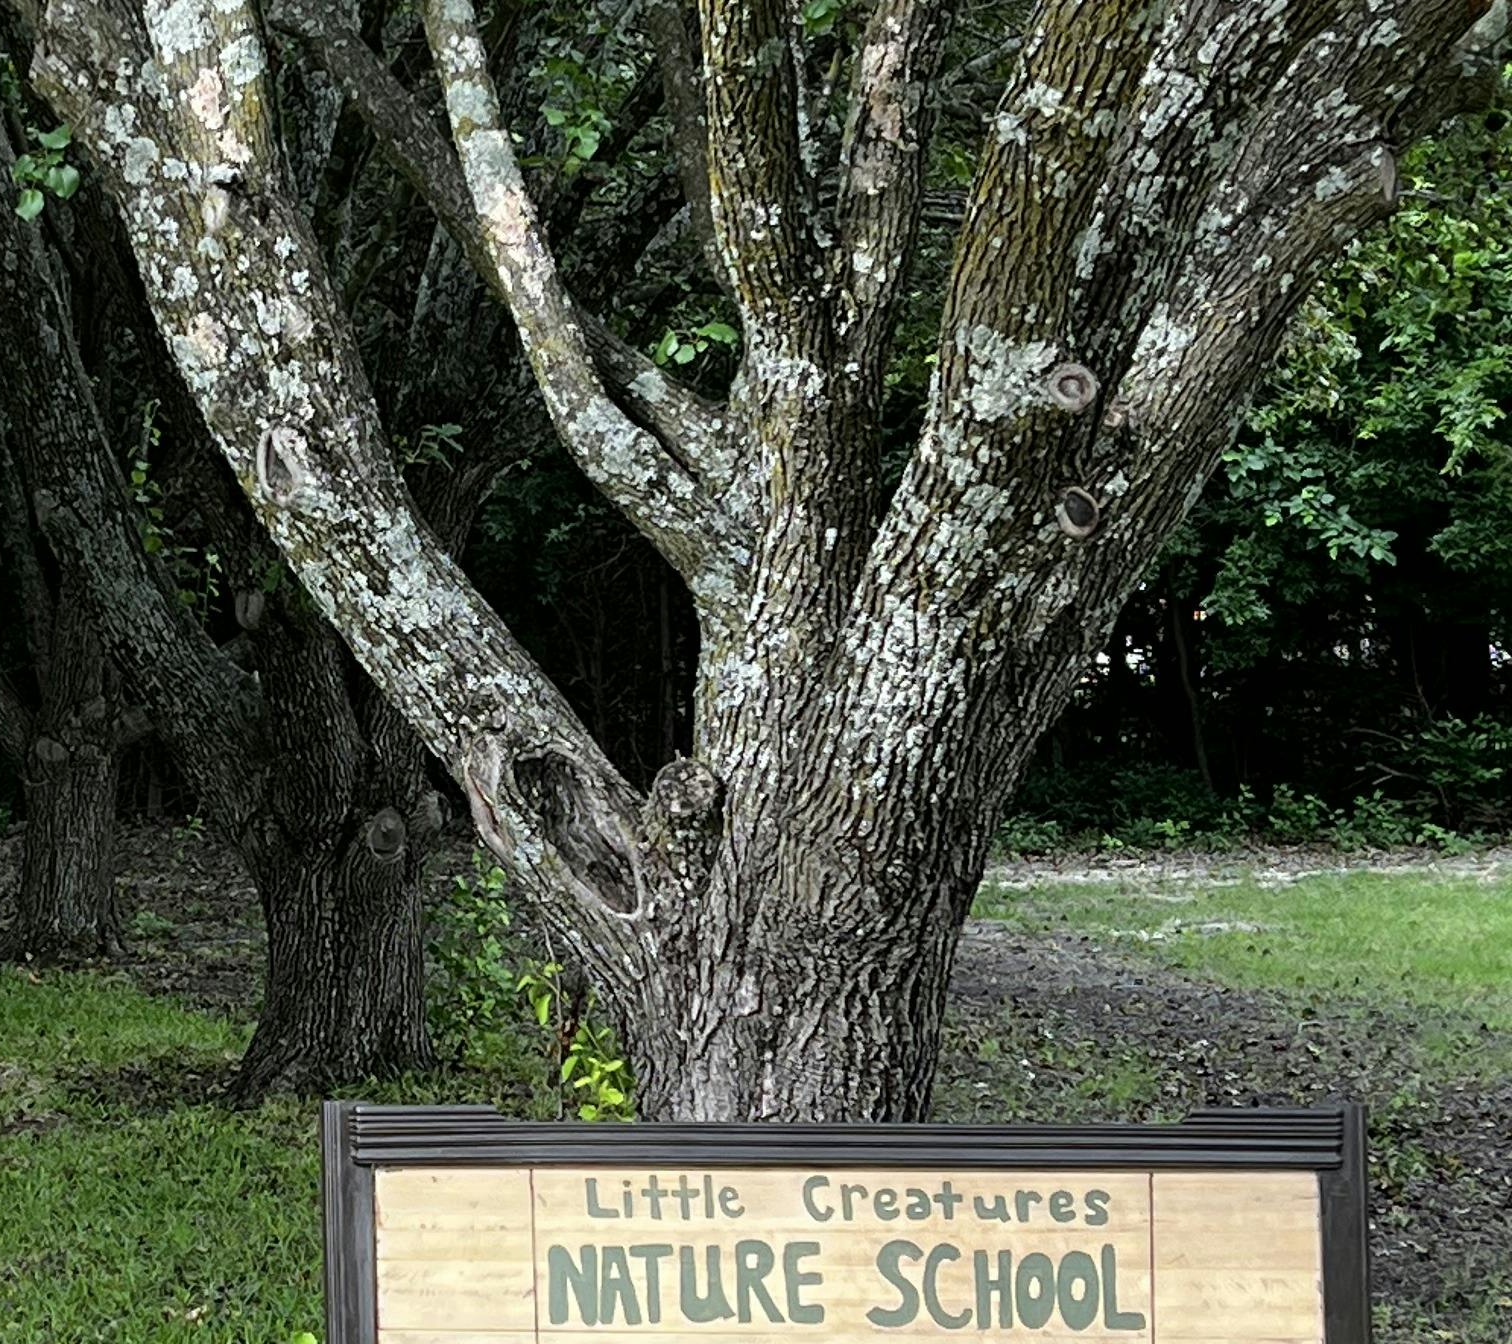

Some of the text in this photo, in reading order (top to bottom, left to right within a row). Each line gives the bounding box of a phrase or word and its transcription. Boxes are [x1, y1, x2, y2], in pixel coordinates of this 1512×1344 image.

[584, 1174, 1111, 1226] Little Creatures
[547, 1240, 1146, 1331] NATURE SCHOOL
